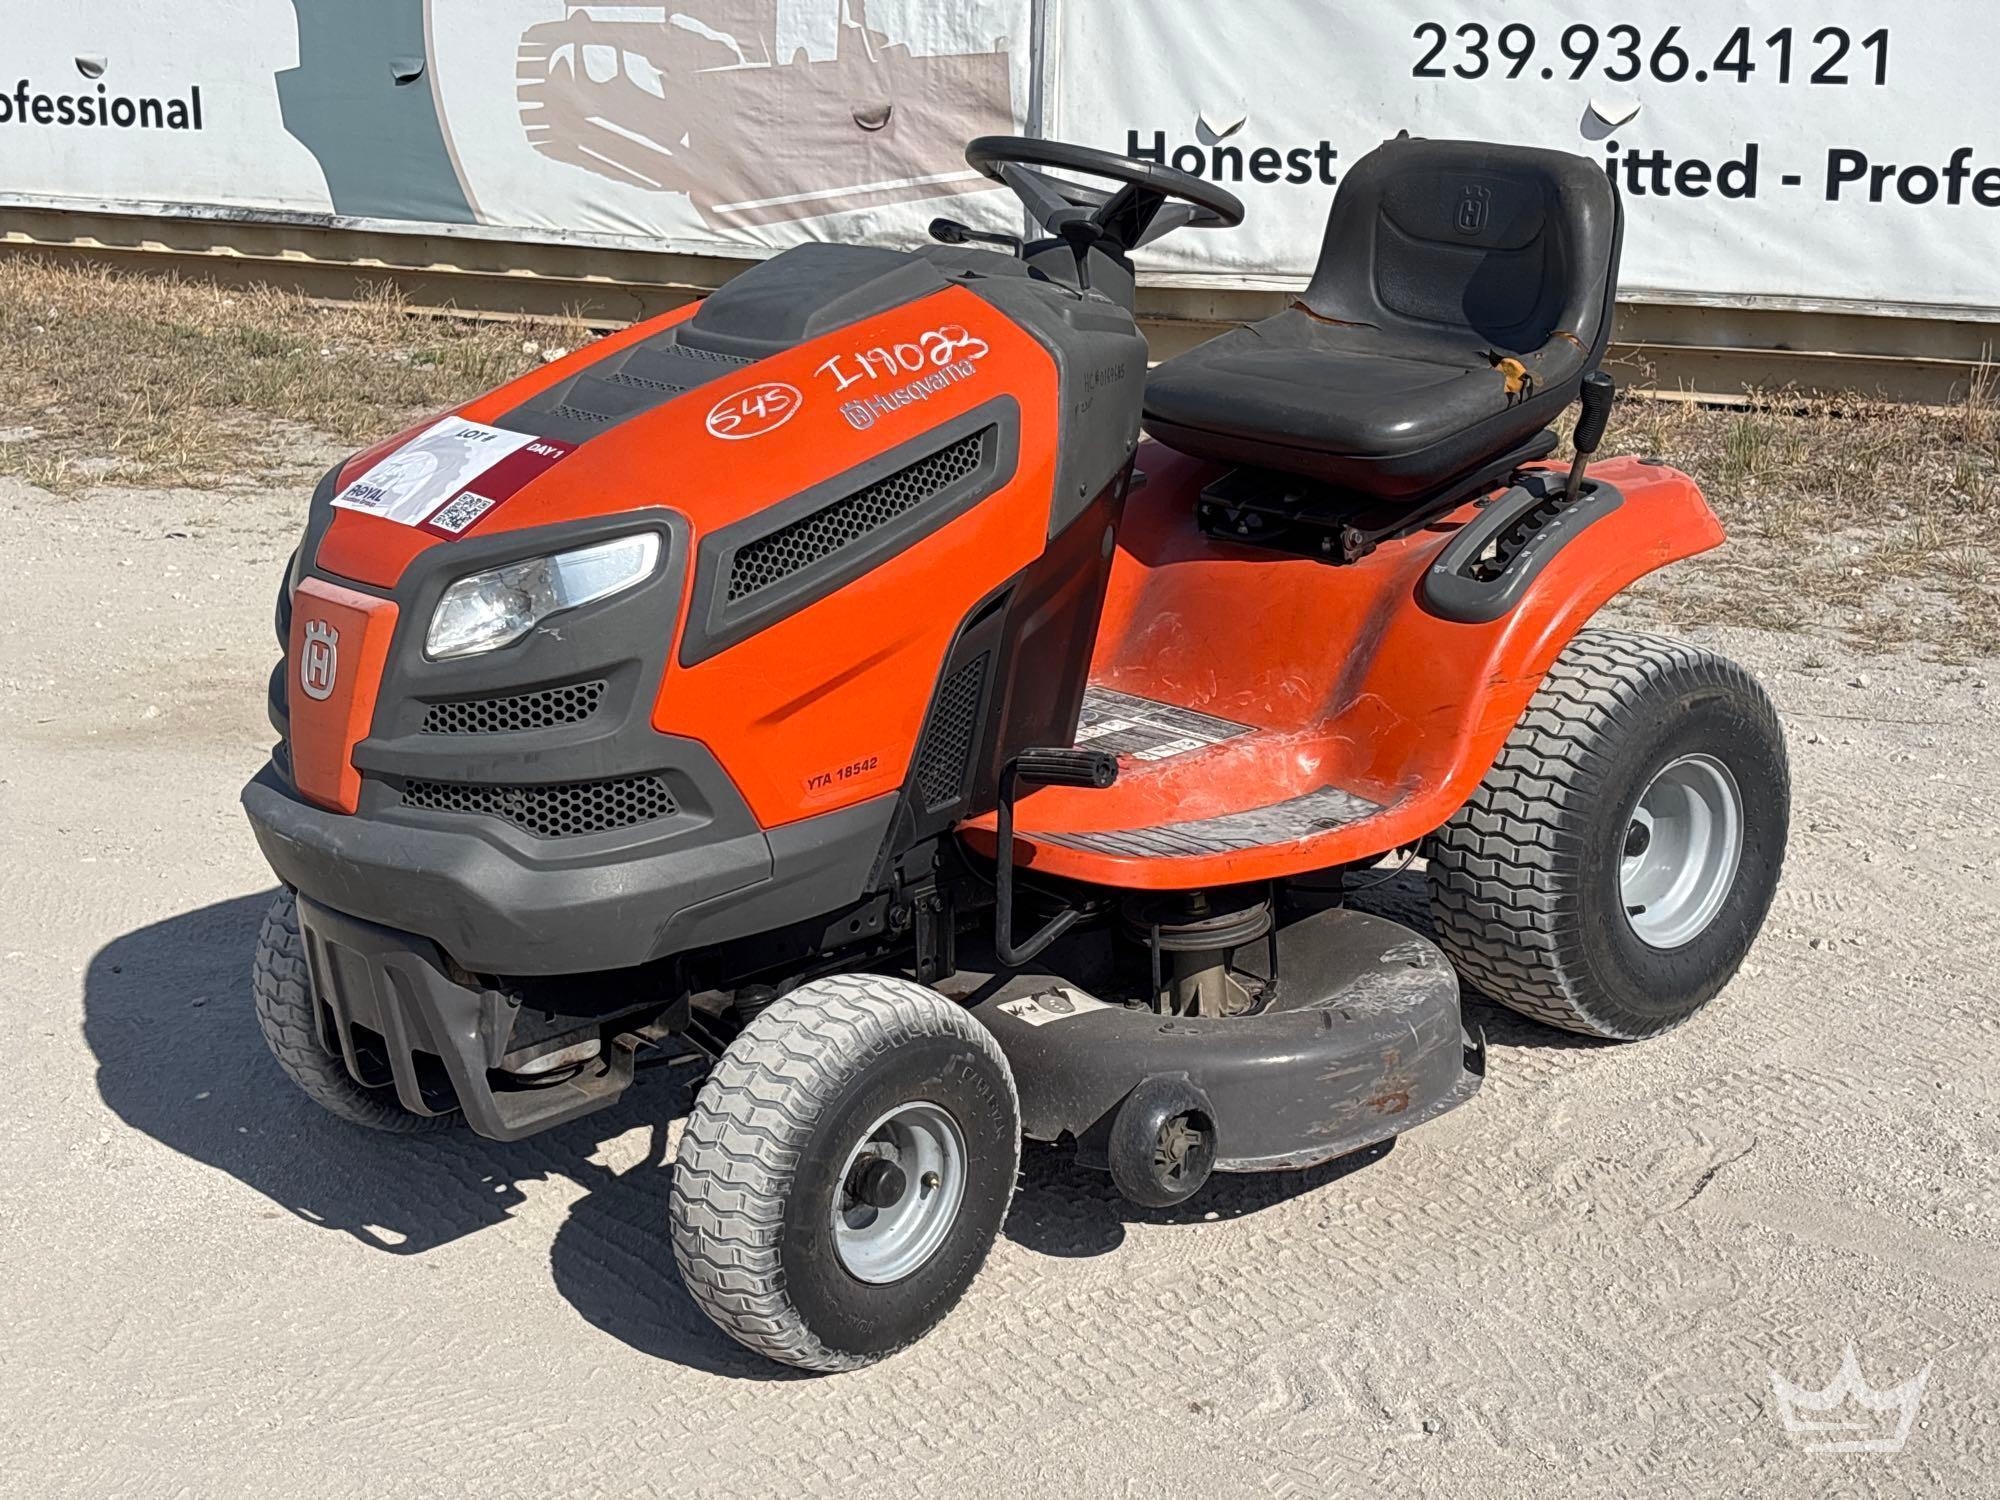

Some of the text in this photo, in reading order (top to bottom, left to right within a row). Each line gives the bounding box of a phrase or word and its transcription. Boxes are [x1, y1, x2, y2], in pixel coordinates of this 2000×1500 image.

[1412, 22, 1888, 85] 239.936.4121
[1127, 129, 1338, 185] Honest
[1825, 147, 2000, 207] Profe
[864, 358, 976, 418] Husqvarna
[455, 428, 489, 441] LOT
[526, 443, 558, 457] DAY
[345, 484, 388, 503] ROYAL
[807, 756, 878, 791] YTA 18542
